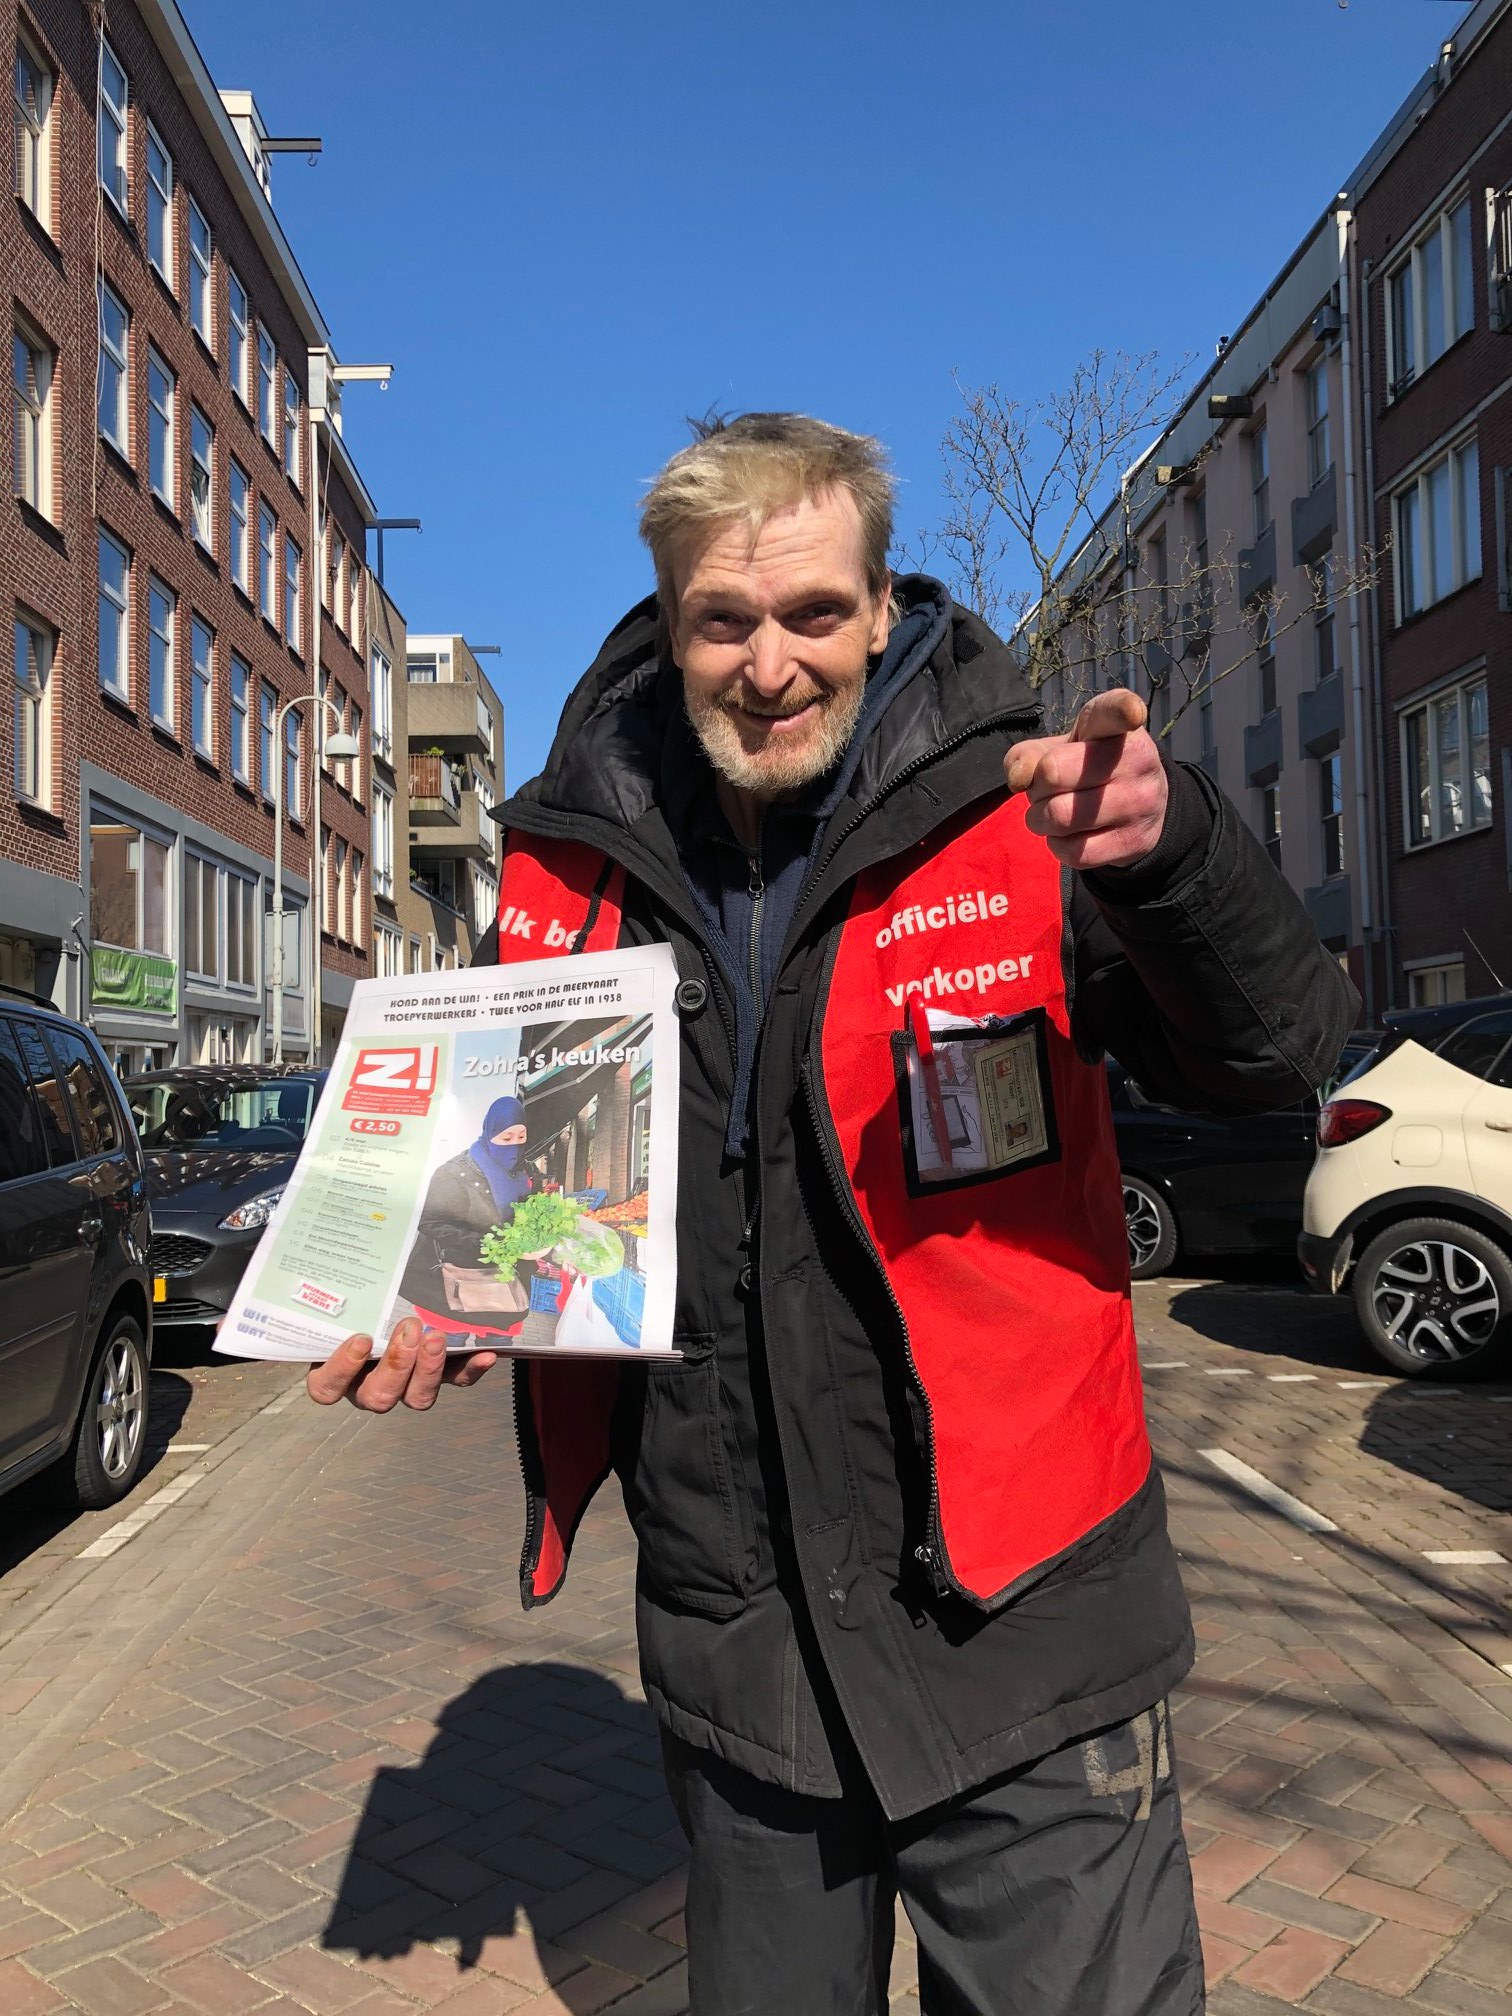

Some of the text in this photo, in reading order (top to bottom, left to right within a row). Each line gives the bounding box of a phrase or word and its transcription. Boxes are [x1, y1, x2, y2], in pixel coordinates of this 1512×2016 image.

[499, 906, 537, 939] Ik
[875, 890, 1009, 949] officiële
[384, 993, 622, 1022] TROEPVERWERKERS TWEE VOOR HALF ELF IN 1938
[390, 978, 619, 1008] HOND AAN DE LIJN! EEN PRIK IN DE MEERVAART
[355, 1042, 435, 1090] Z!
[462, 1043, 641, 1078] Zohra's keuken
[354, 1121, 396, 1132] € 2,50
[243, 1307, 269, 1323] WIE
[302, 1292, 331, 1310] krant
[237, 1322, 266, 1338] WAT
